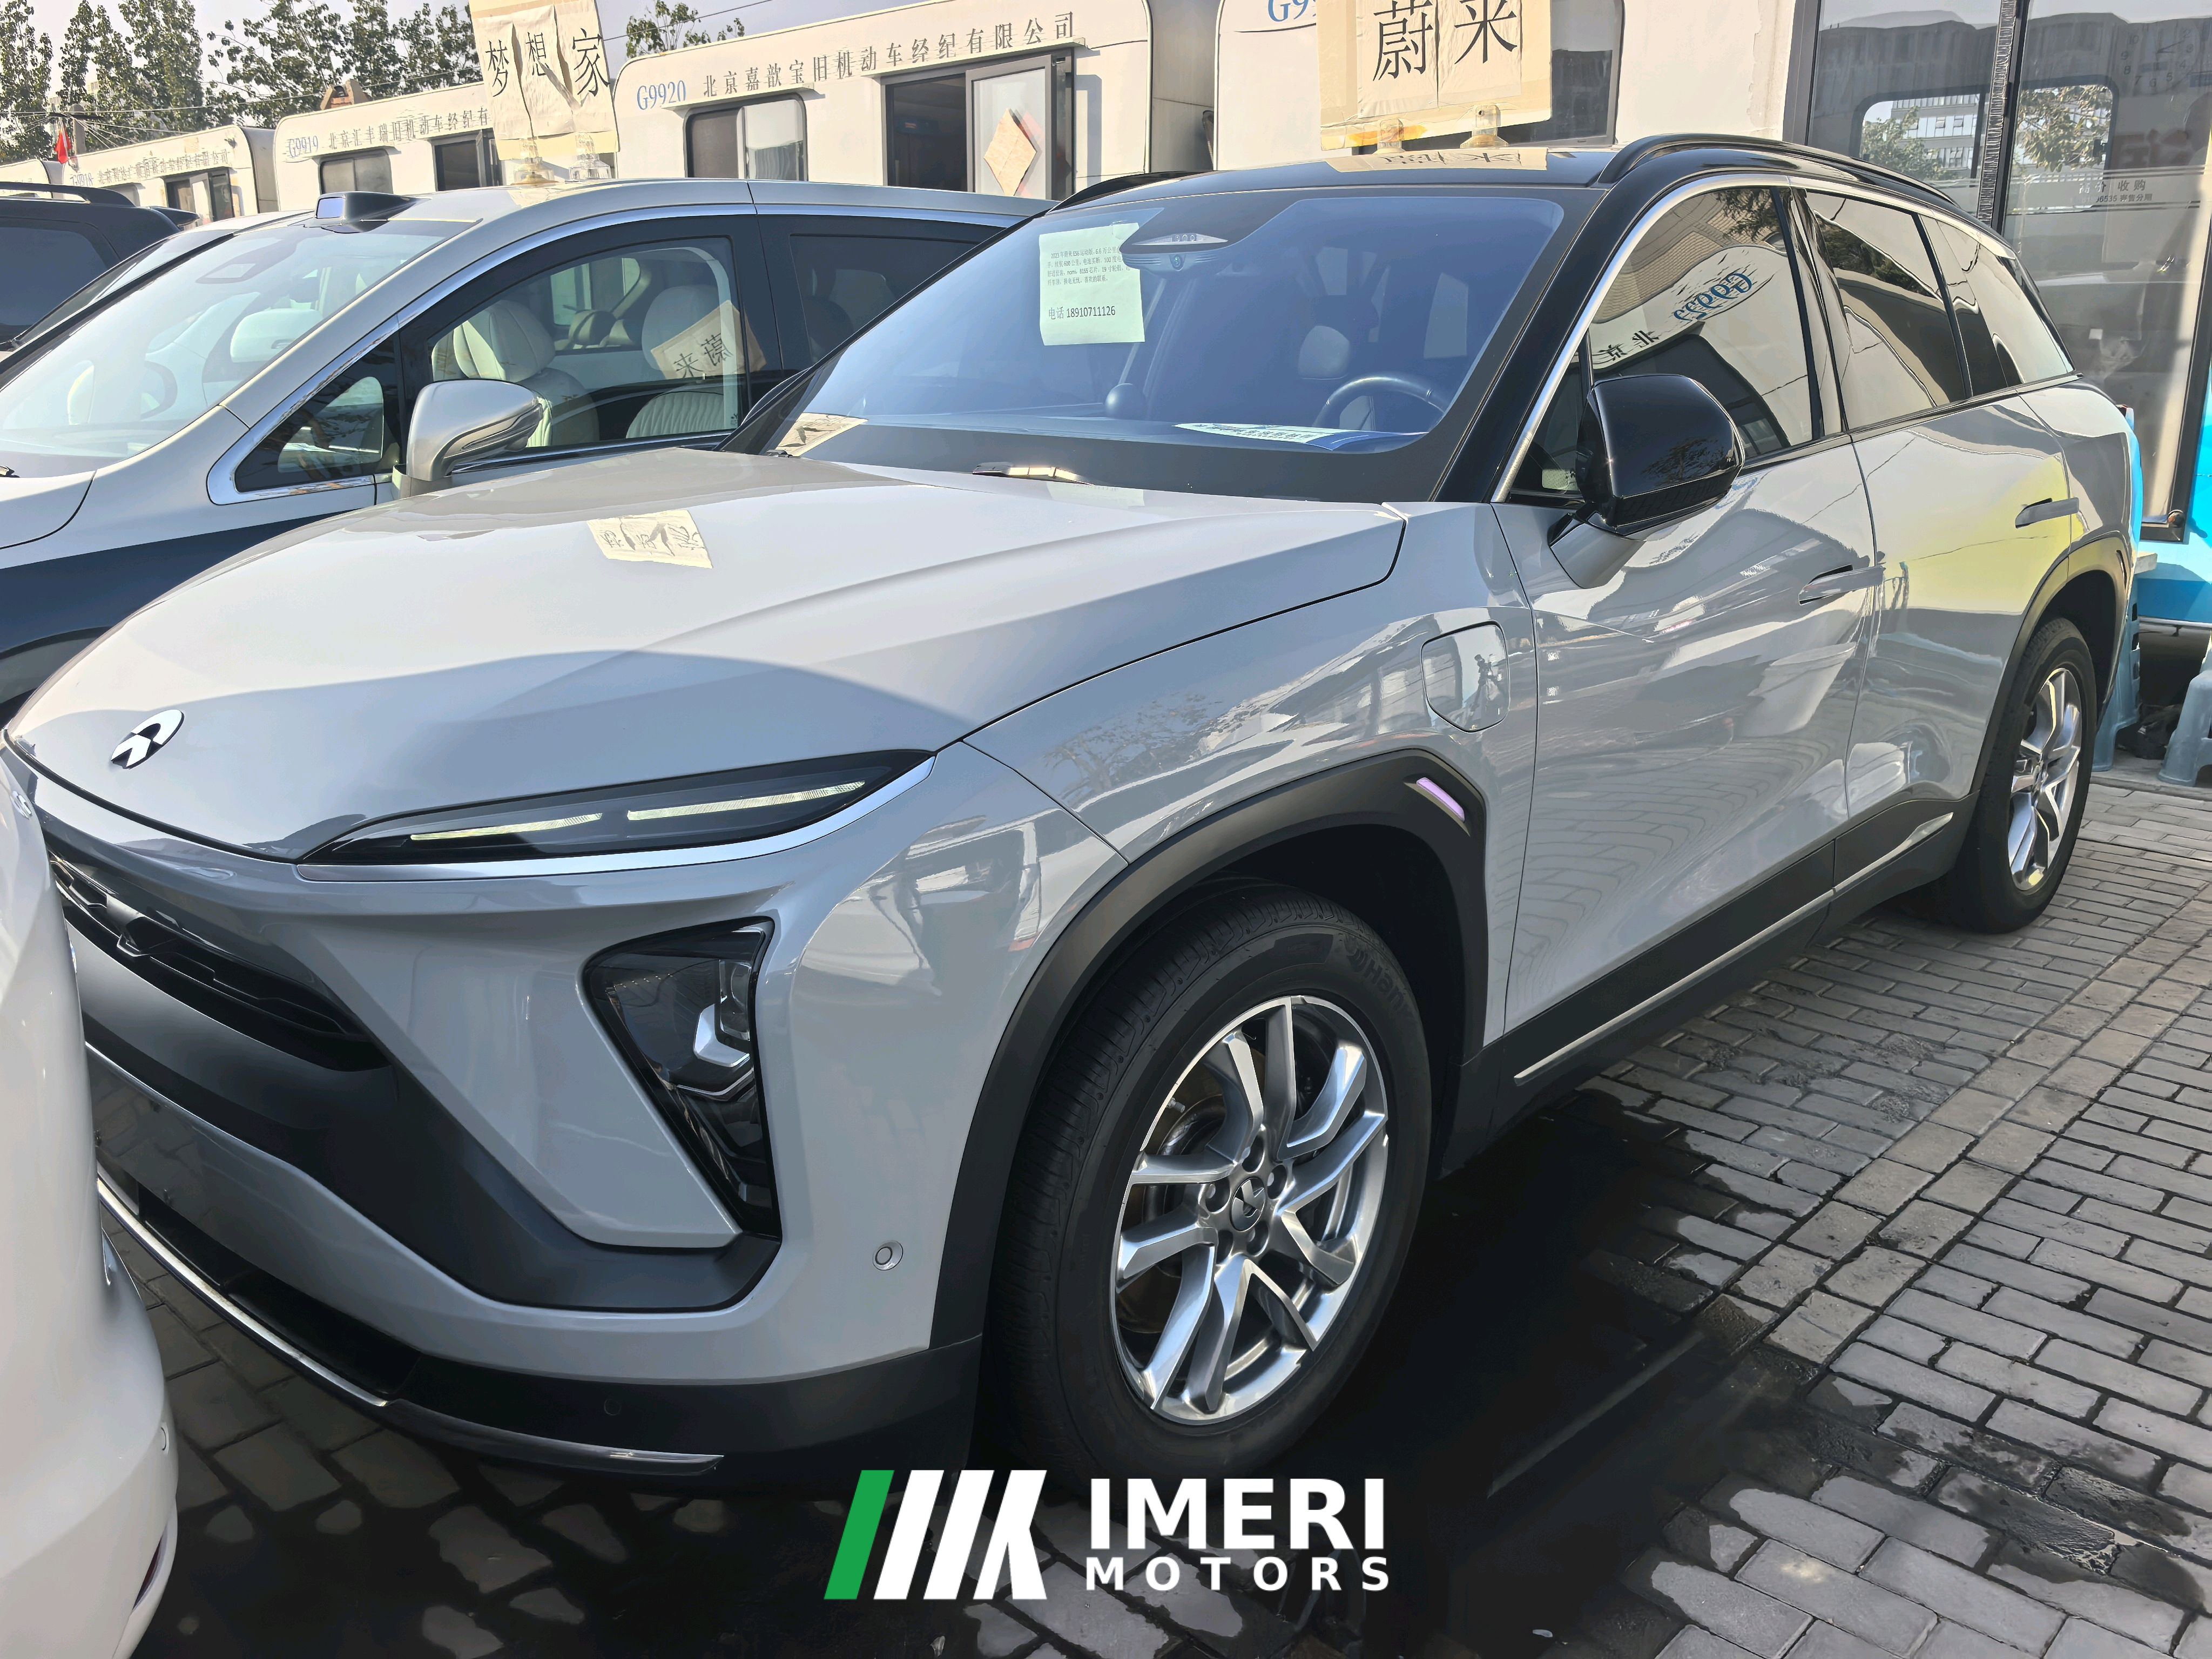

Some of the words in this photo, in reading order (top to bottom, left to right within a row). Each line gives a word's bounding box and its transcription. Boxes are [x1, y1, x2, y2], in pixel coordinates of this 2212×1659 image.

[1267, 0, 1316, 22] G9
[485, 28, 611, 97] 梦想家
[637, 80, 686, 110] G9920
[704, 11, 1073, 98] 北京嘉歆宝旧机动车经纪有限公司
[1372, 0, 1518, 82] 蔚来
[288, 135, 319, 158] G9919
[1049, 307, 1064, 320] 电话
[1067, 306, 1116, 318] 18910711126
